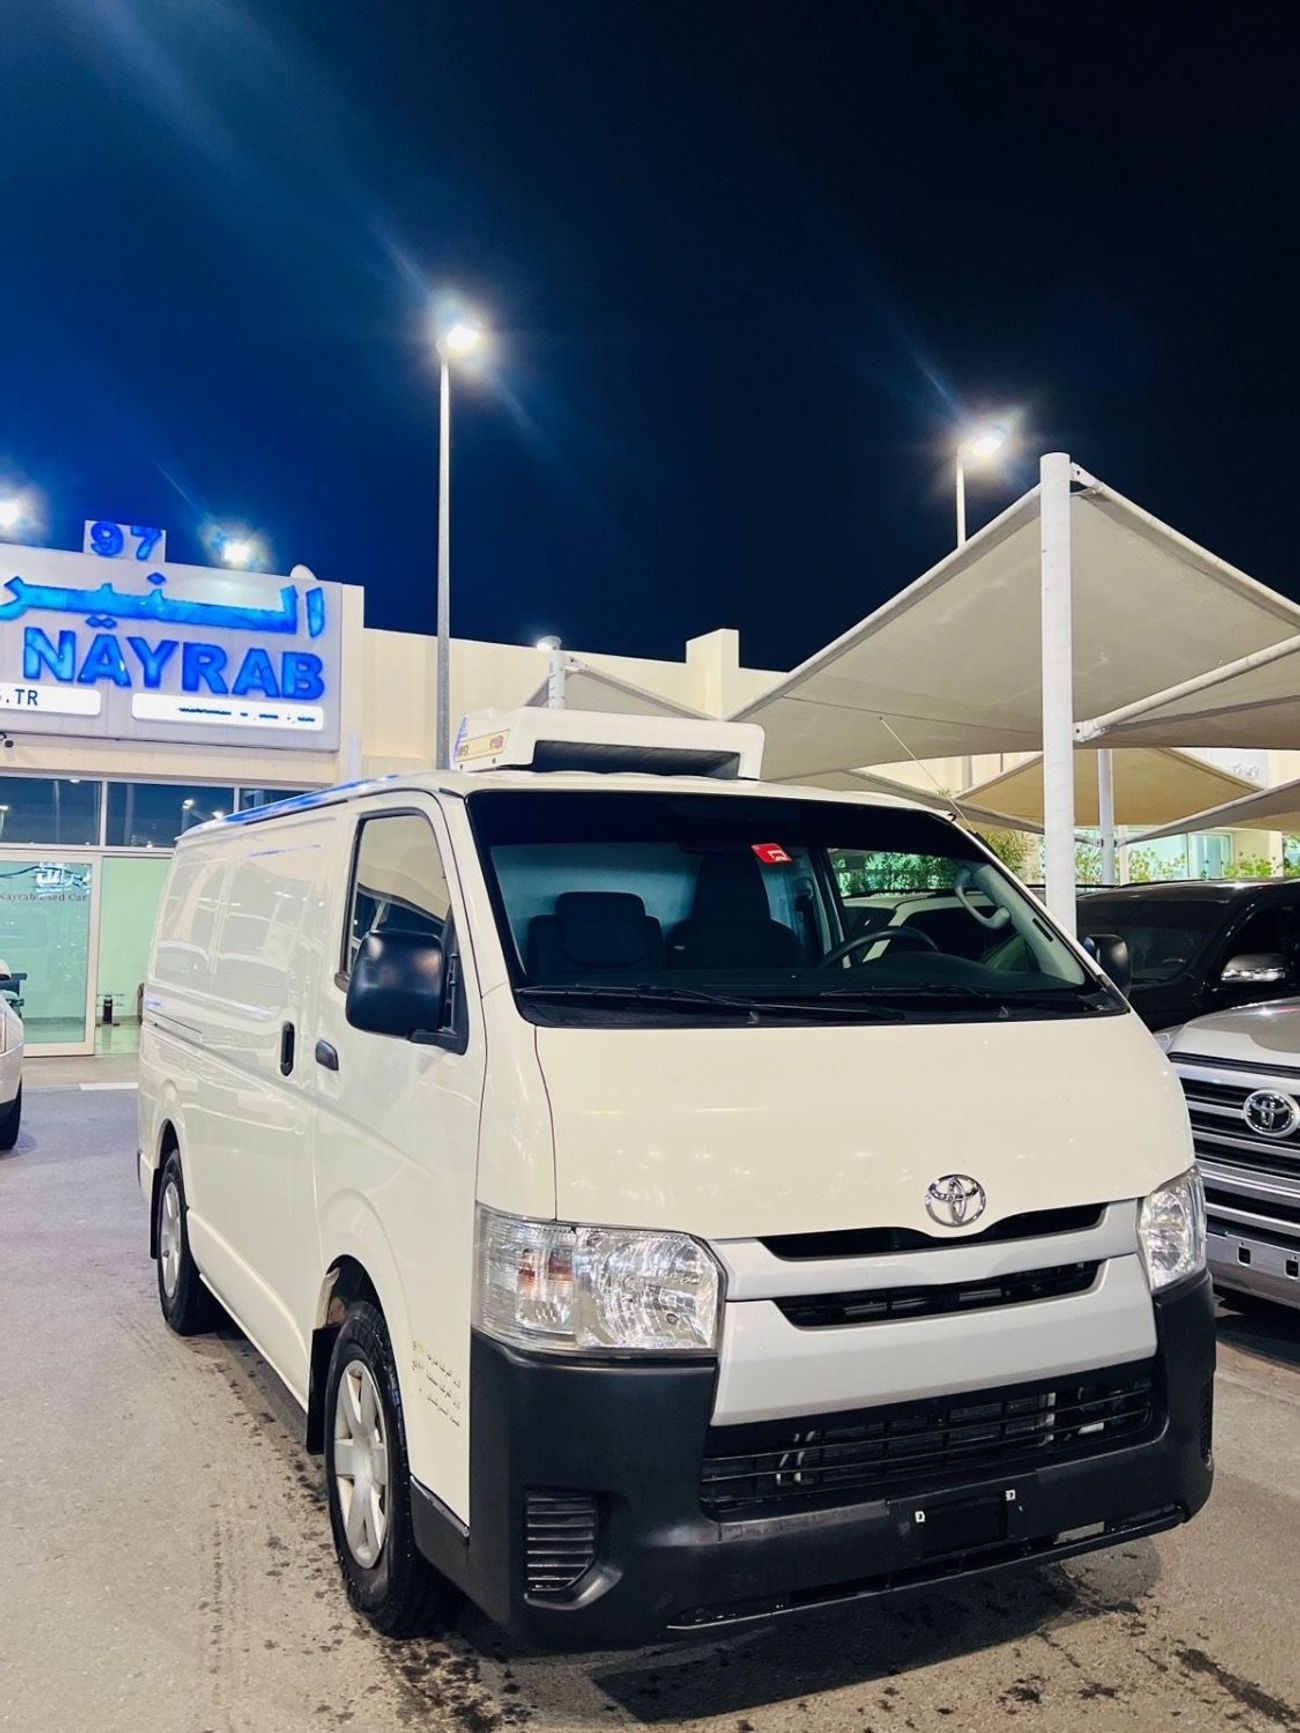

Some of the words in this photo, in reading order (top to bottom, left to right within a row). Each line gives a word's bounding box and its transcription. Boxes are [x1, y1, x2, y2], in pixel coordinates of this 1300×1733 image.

[90, 520, 163, 560] 97
[23, 626, 325, 701] NAYRAB
[0, 688, 38, 706] .TR
